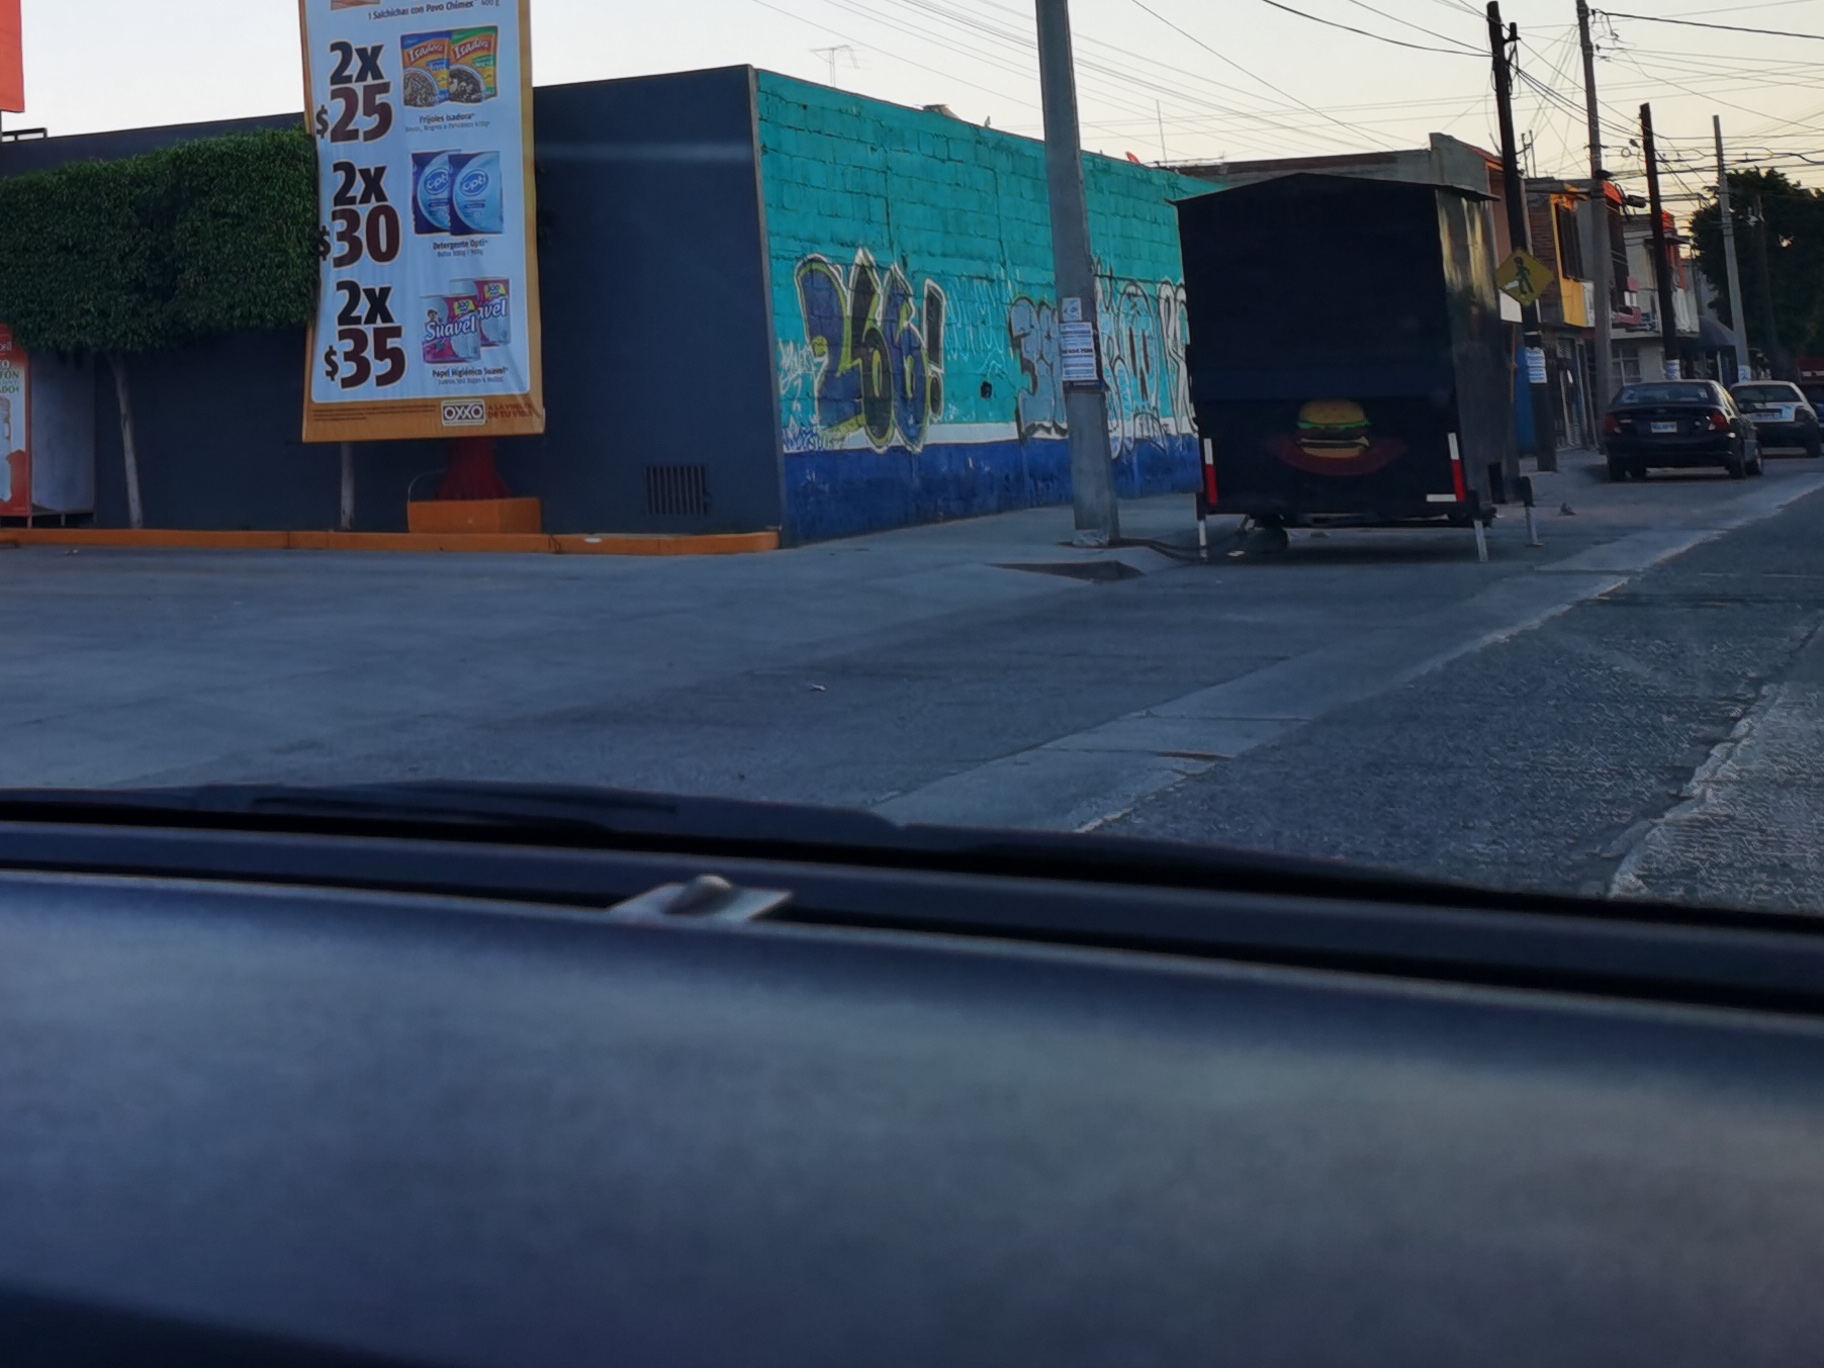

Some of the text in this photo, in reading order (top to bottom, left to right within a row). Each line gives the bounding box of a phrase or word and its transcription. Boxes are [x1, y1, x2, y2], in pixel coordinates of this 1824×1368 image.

[407, 44, 443, 62] Isadora
[454, 37, 489, 59] Isadora
[316, 81, 393, 143] $25
[425, 315, 477, 341] Suavel
[324, 326, 406, 389] $35
[443, 403, 484, 420] OXXO
